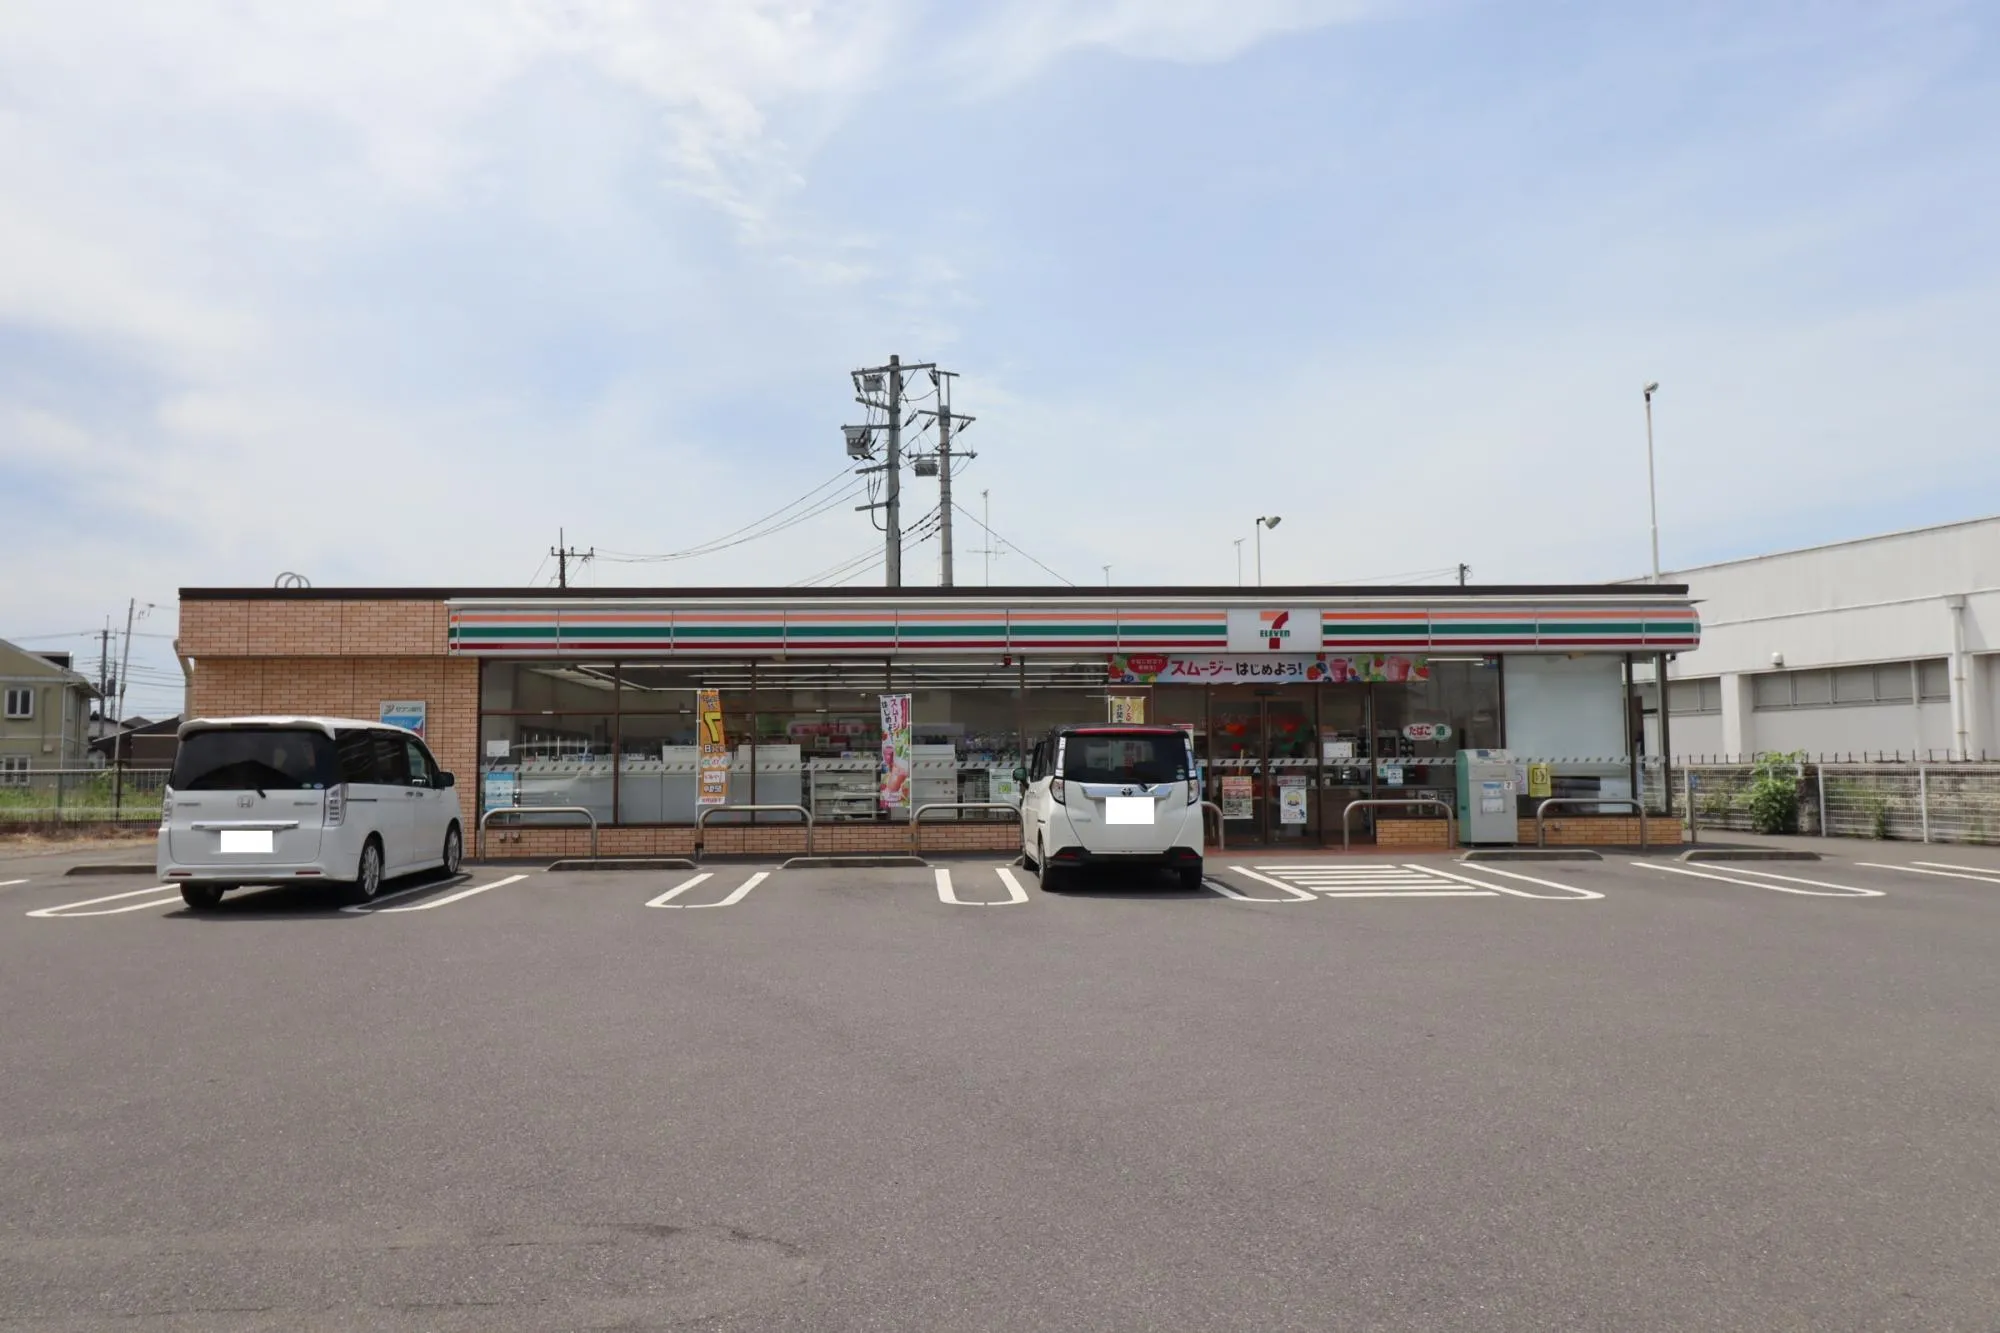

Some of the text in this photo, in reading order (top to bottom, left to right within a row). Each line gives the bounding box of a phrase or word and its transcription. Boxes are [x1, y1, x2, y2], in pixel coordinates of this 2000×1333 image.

[1171, 660, 1233, 677] スムージー
[1408, 726, 1432, 736] たばこ
[1435, 725, 1446, 736] 酒
